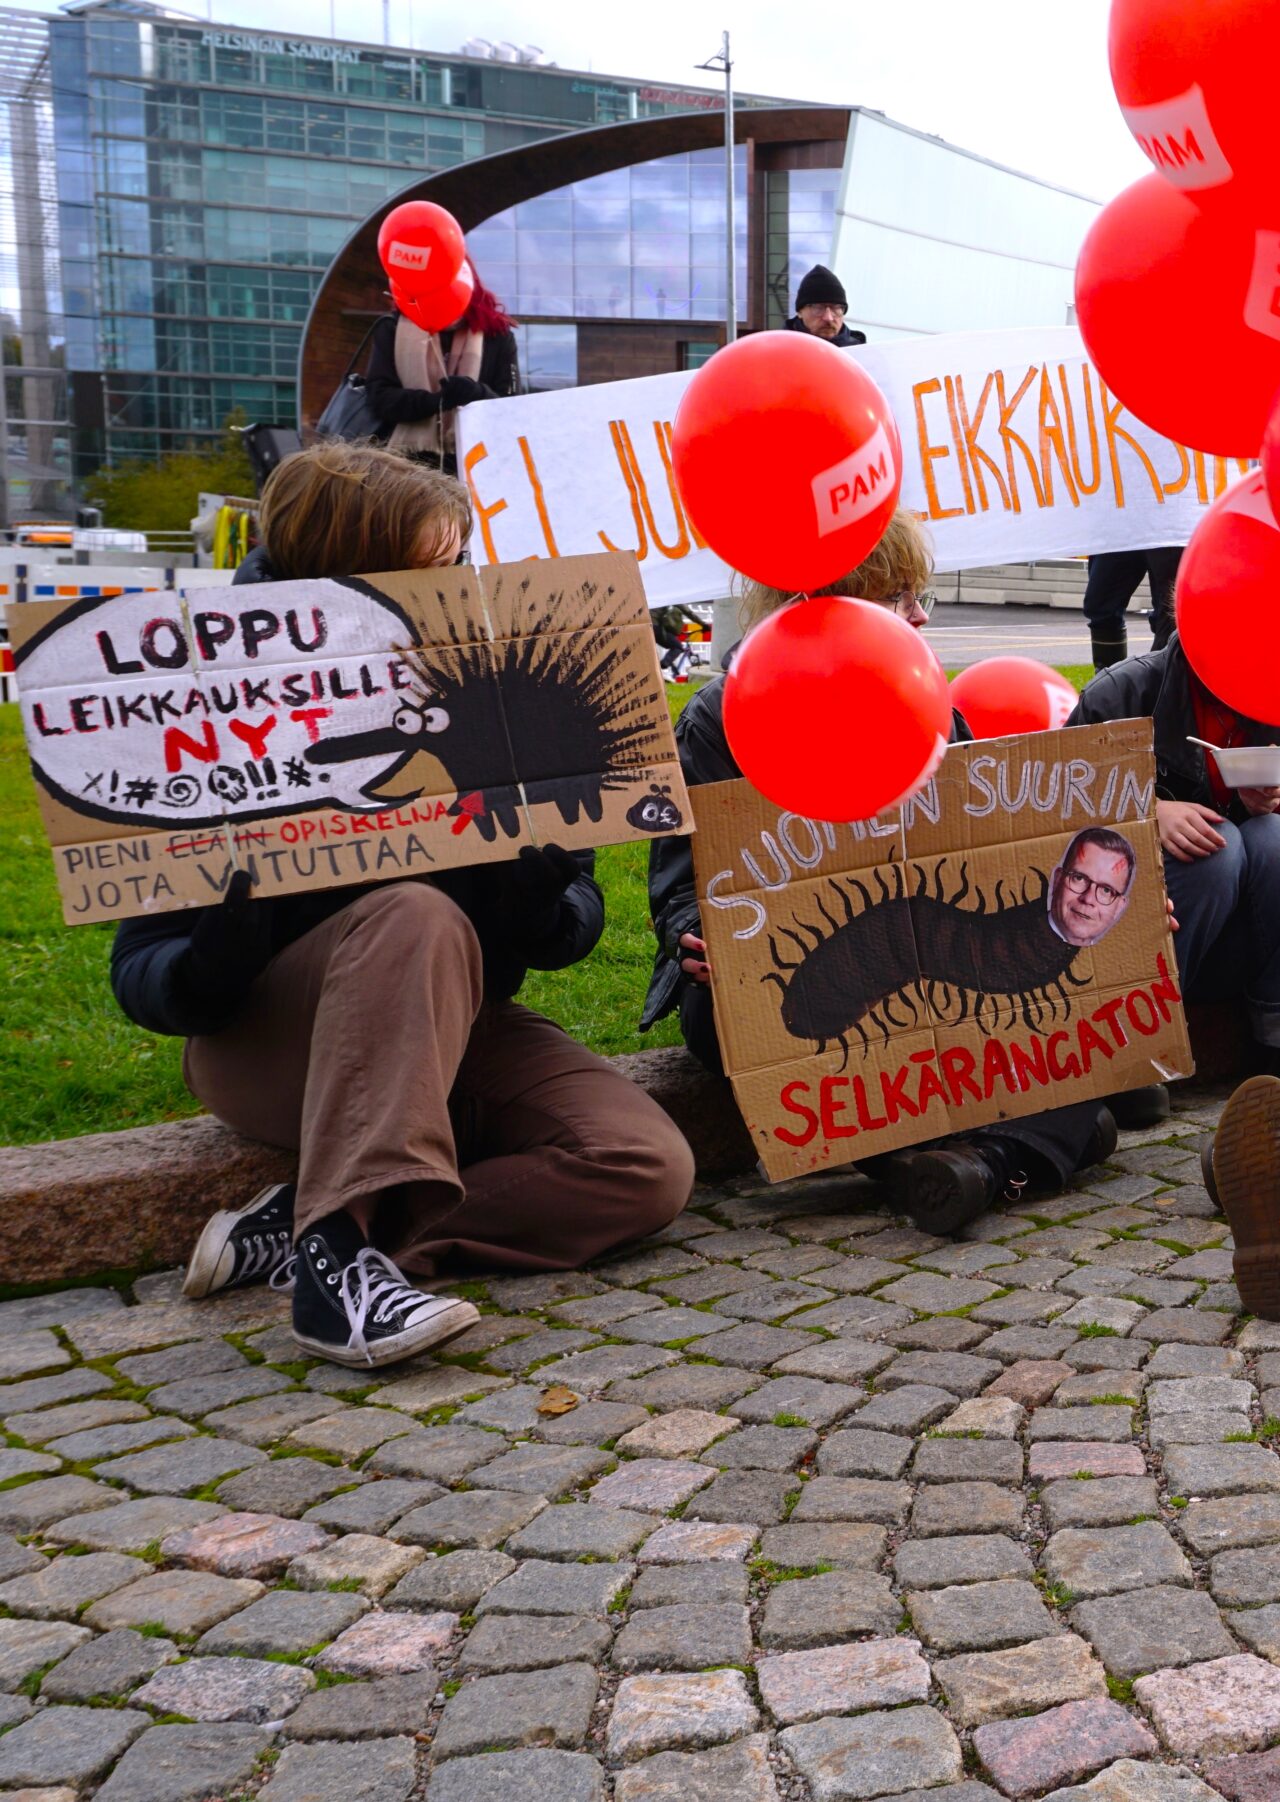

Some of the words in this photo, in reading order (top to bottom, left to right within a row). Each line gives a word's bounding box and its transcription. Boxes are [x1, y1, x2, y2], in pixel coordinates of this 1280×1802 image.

[201, 30, 285, 55] HELSINGIN
[288, 41, 361, 64] SANOMAT
[395, 249, 424, 265] PAM
[830, 451, 888, 515] PAM
[97, 608, 329, 675] LOPPU
[33, 659, 413, 736] LEIKKAUKSILLE
[163, 706, 334, 773] NYT
[63, 839, 152, 874] PIENI
[280, 801, 452, 844] OPISKELIJA
[704, 777, 941, 941] SUON
[963, 755, 1155, 822] SUURIN
[73, 872, 176, 913] JOTA
[197, 833, 435, 893] VITUTTAA
